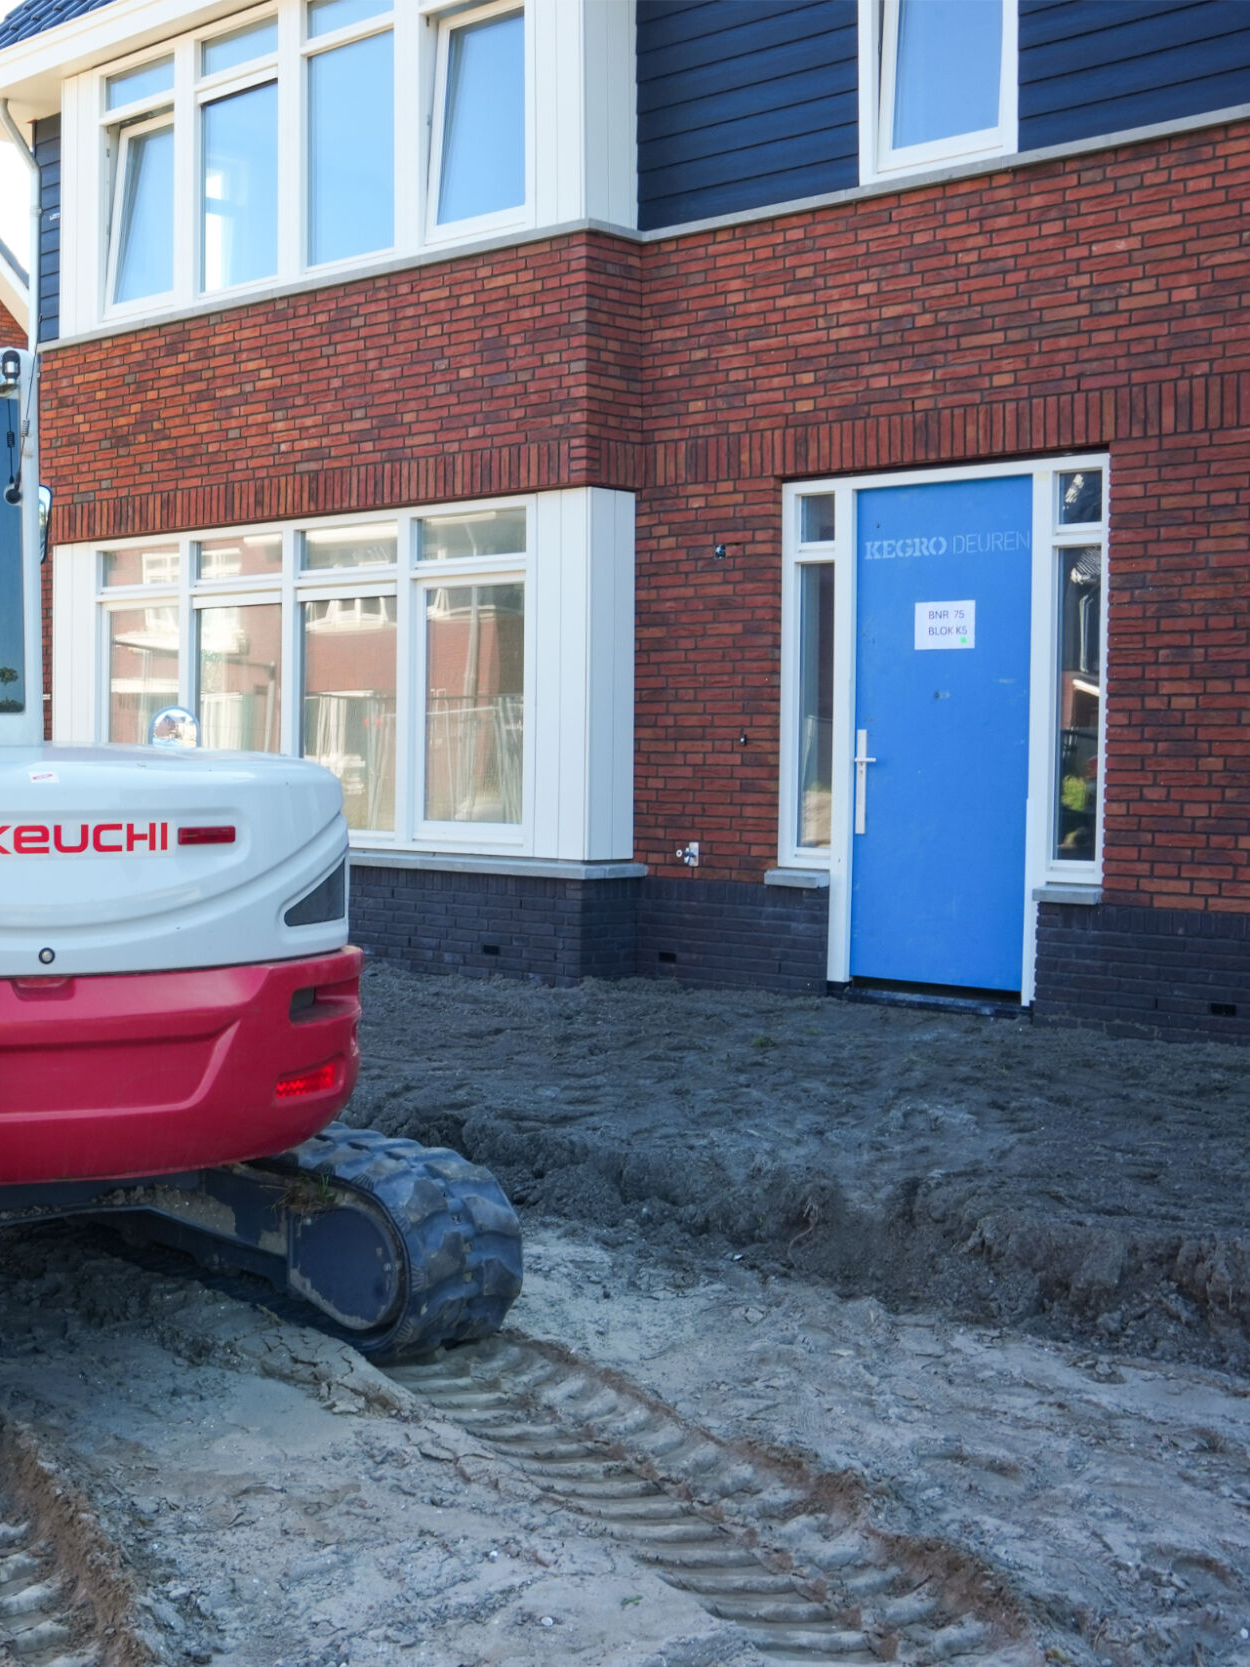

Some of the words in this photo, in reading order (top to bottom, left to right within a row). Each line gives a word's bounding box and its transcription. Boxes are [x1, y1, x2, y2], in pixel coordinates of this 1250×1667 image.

[865, 537, 948, 560] KEGRO
[953, 531, 1030, 553] DEUREN
[928, 610, 949, 620] BNR
[954, 610, 965, 619] 75
[928, 627, 954, 636] BLOK
